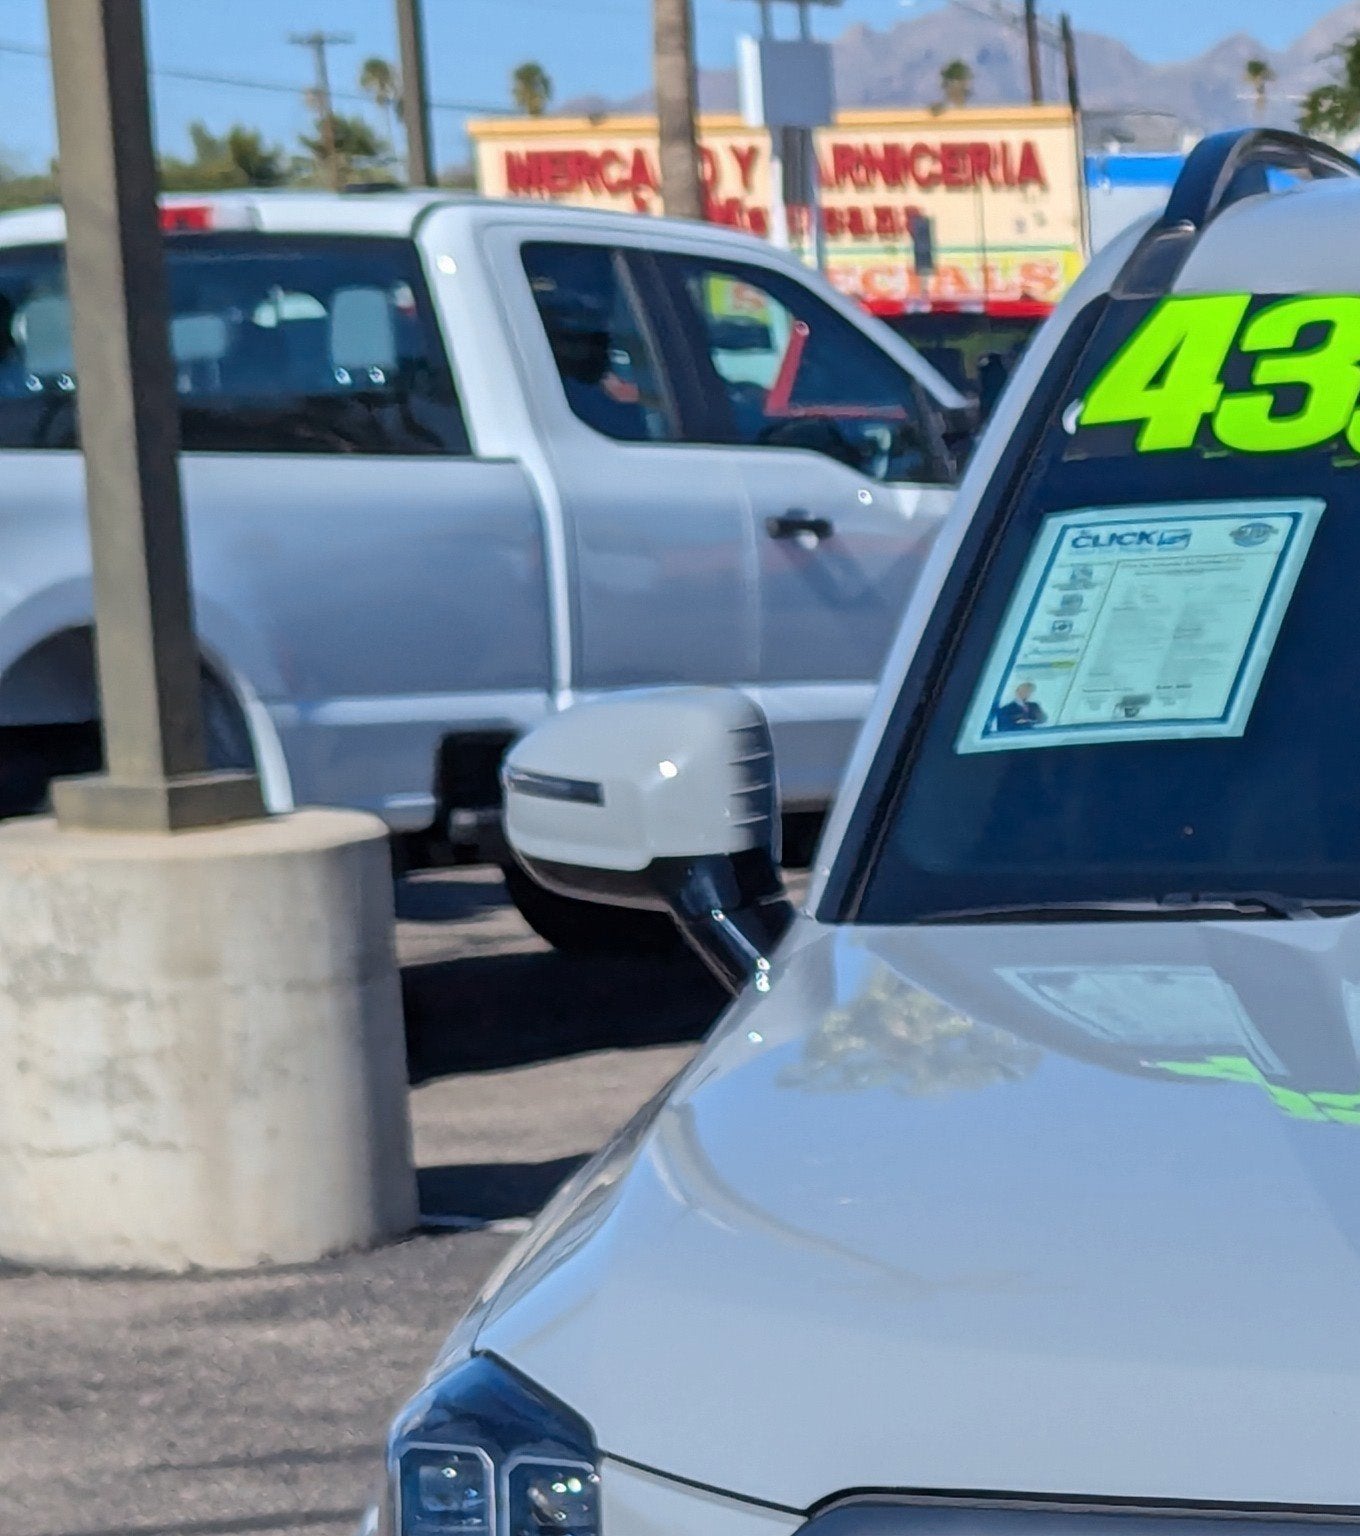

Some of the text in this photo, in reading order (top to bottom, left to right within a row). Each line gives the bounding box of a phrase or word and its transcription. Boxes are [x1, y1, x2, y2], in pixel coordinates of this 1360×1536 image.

[505, 139, 1048, 196] MERCAO Y RNICERIA
